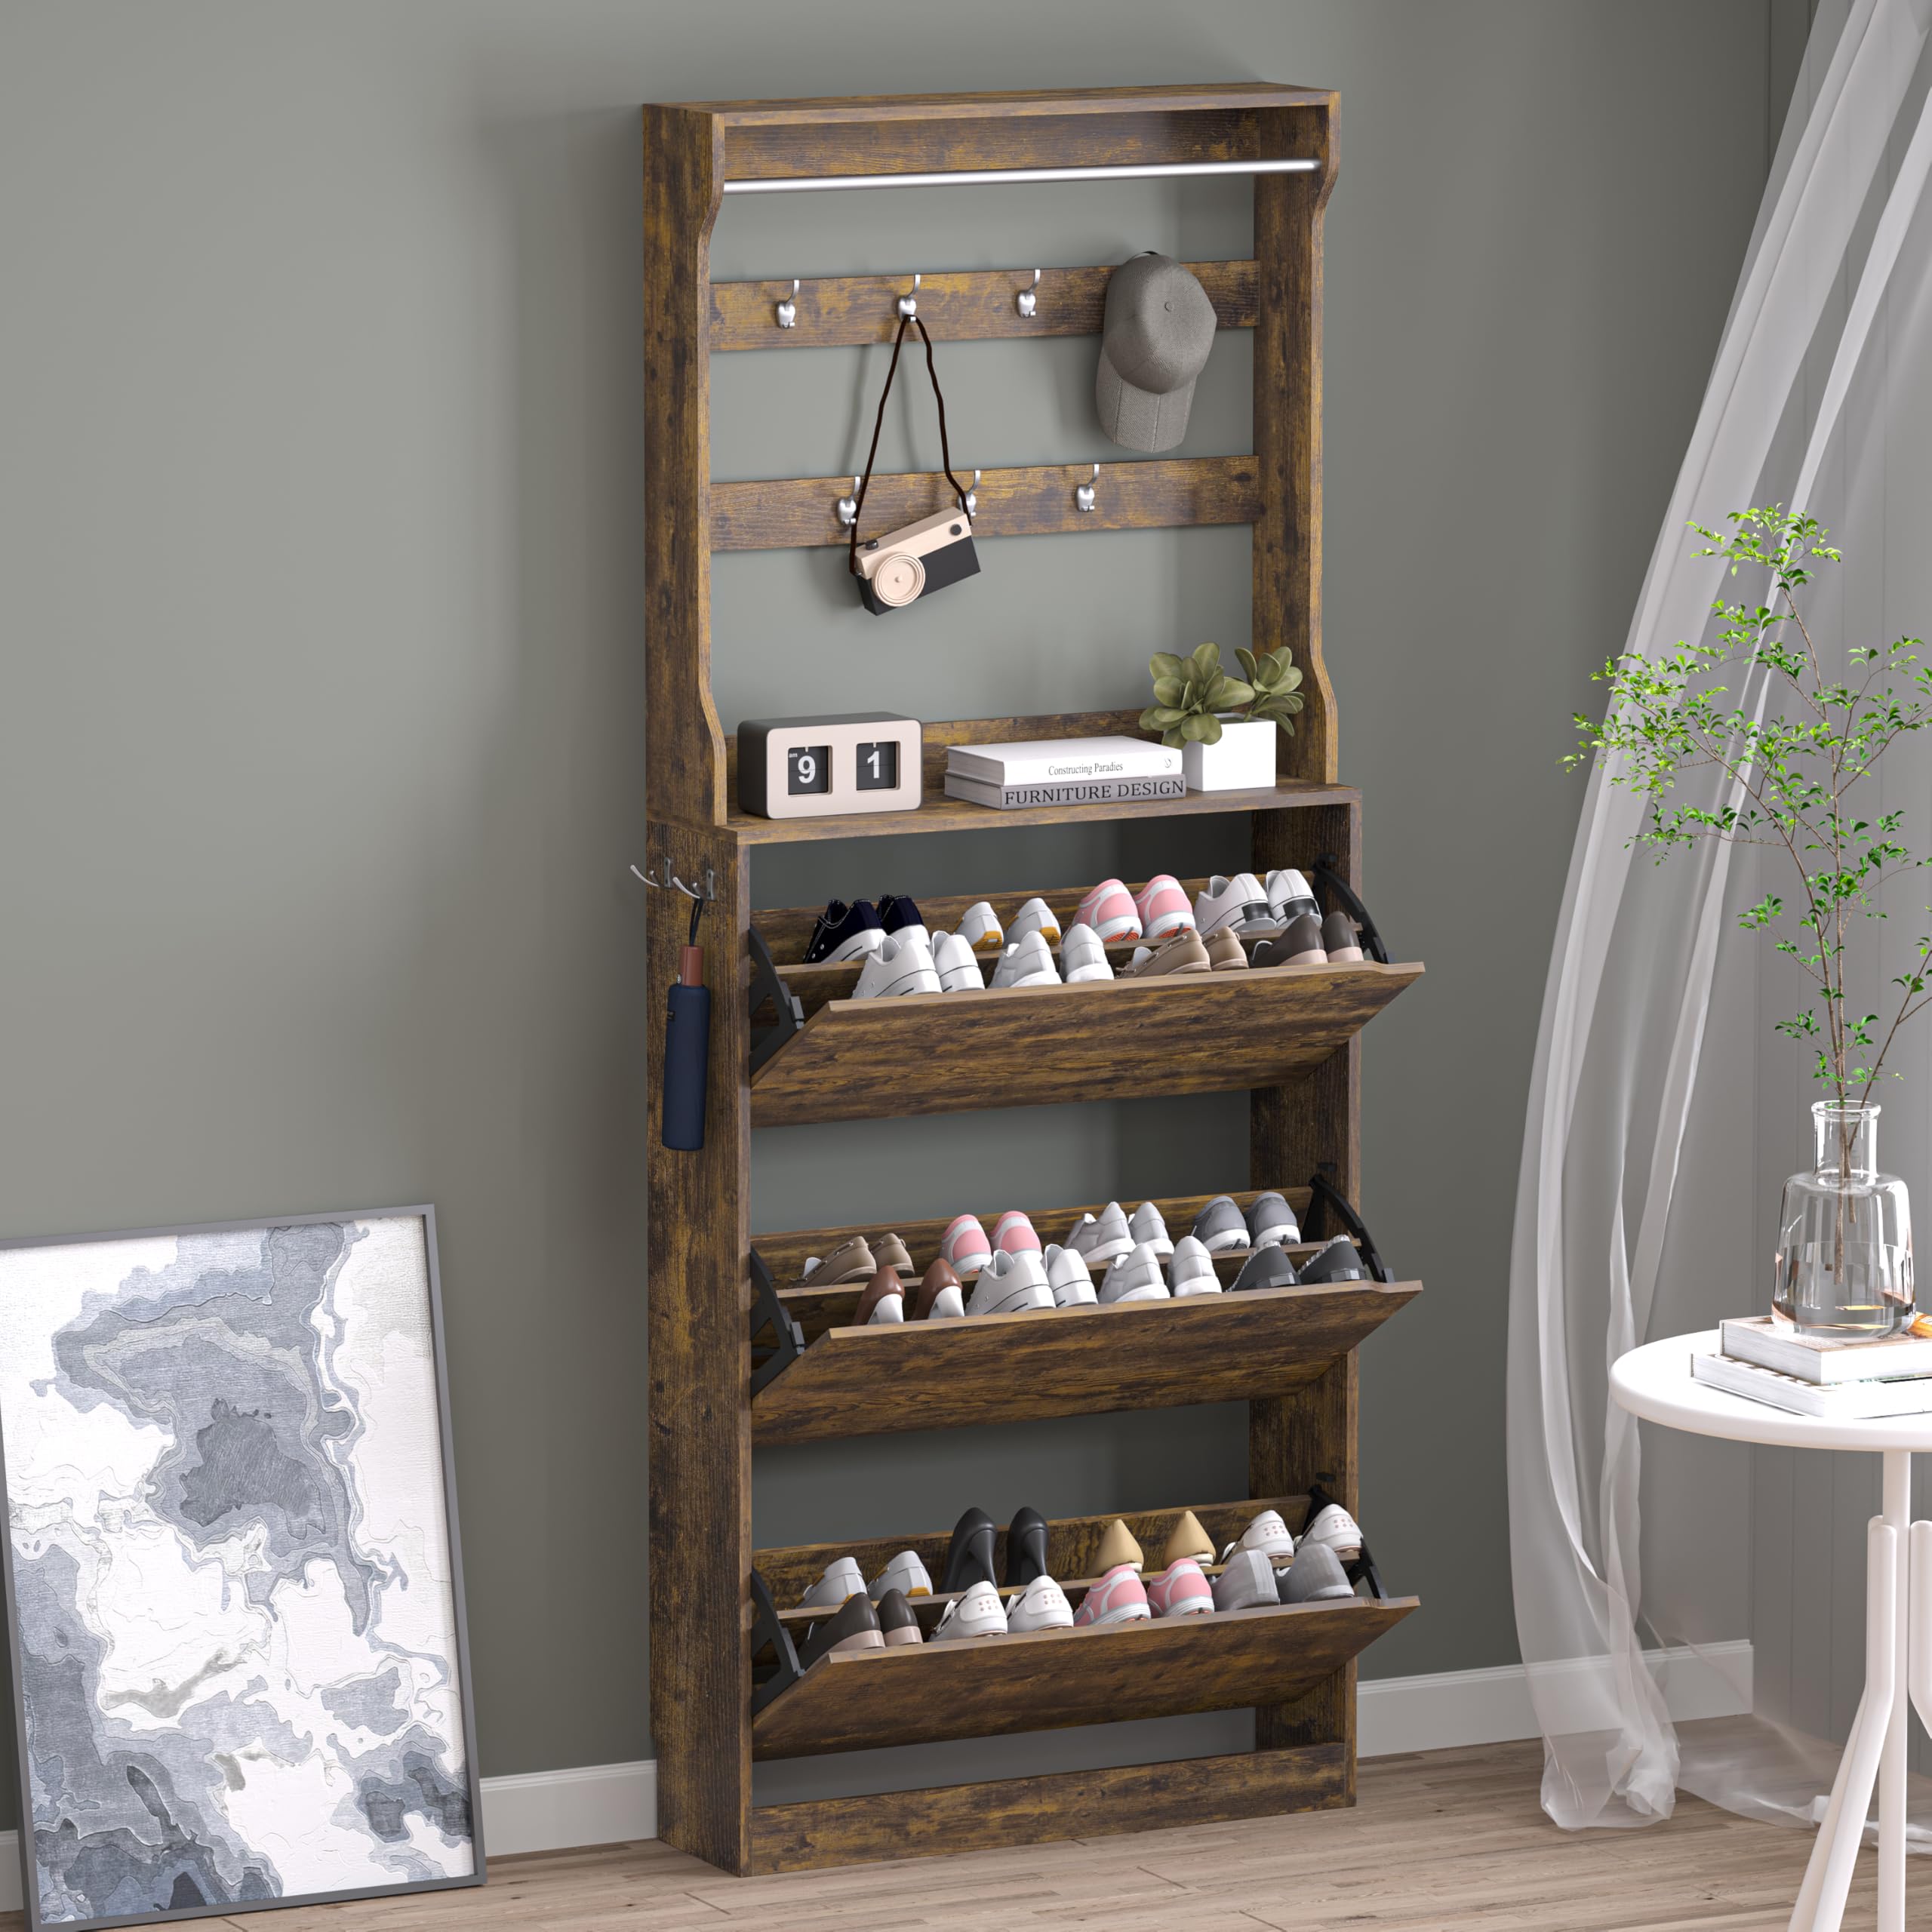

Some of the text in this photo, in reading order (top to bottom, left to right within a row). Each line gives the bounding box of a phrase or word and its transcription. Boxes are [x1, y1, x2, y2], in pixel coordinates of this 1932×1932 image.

[798, 751, 880, 784] 9 1
[1048, 761, 1124, 776] Constructing Paradies
[1004, 780, 1184, 805] FURNITURE DESIGN
